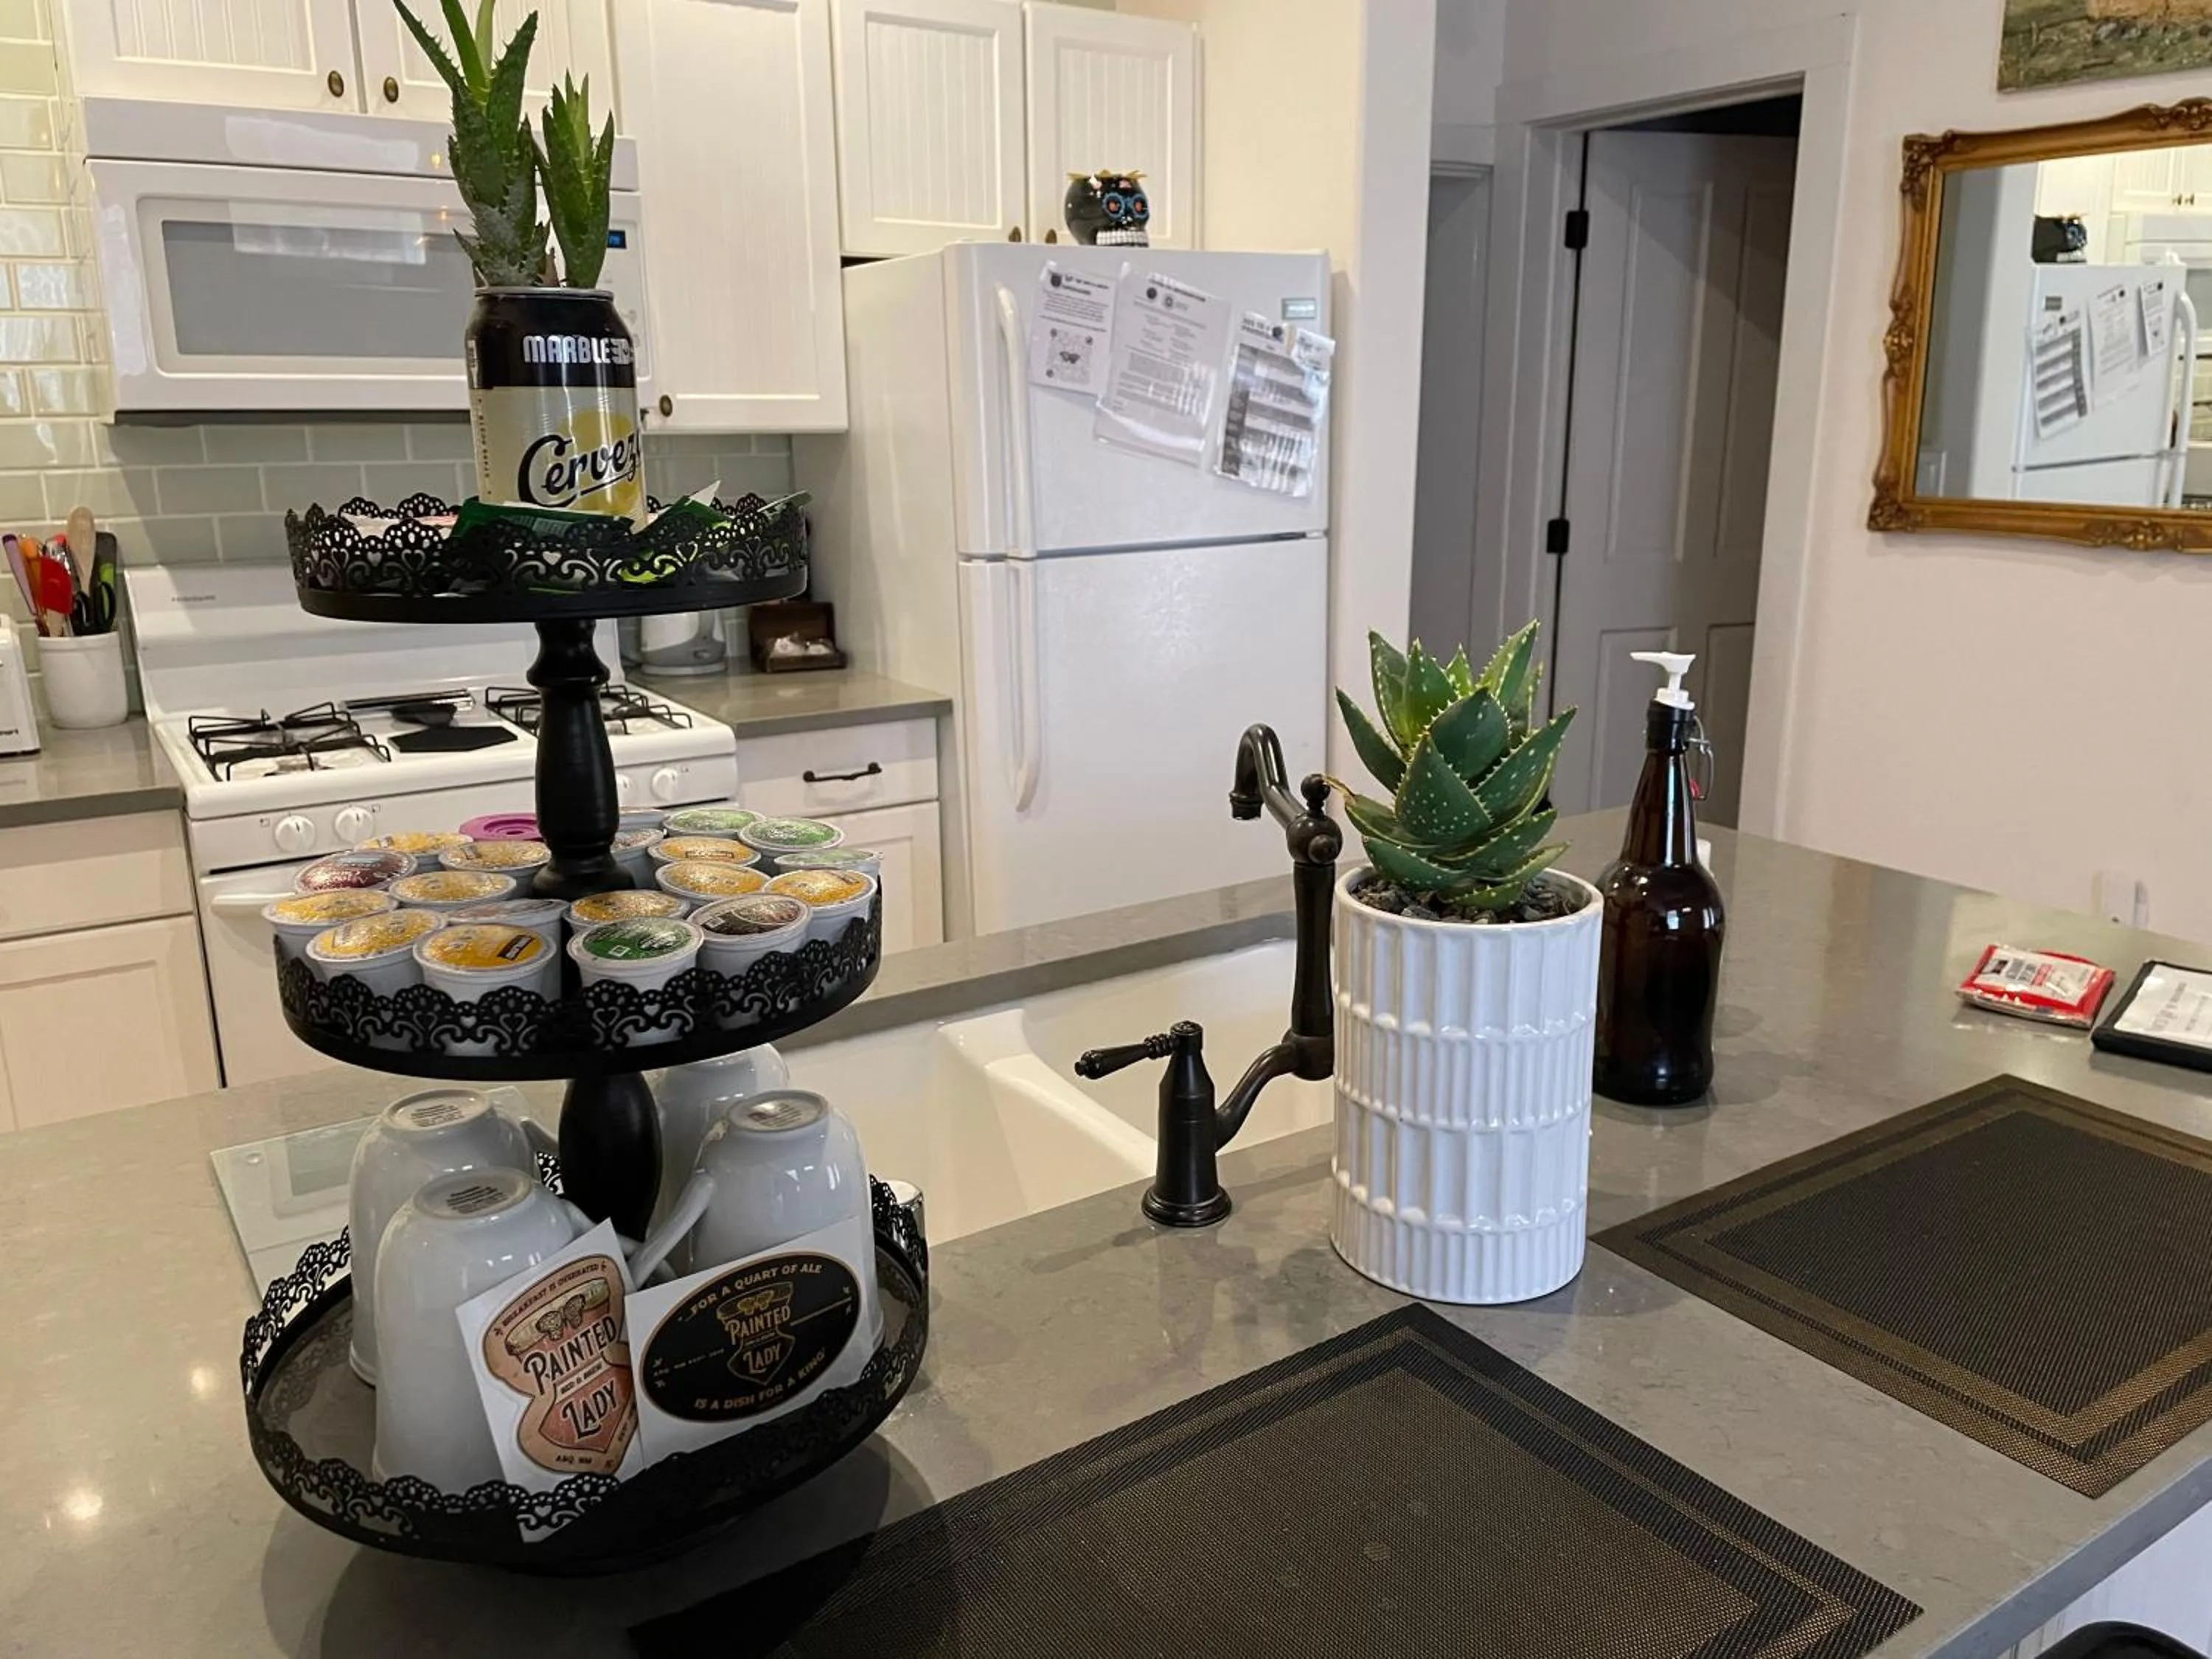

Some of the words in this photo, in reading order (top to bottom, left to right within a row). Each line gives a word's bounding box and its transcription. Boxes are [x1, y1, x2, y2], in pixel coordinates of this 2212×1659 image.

[523, 335, 611, 365] MARBLE
[721, 1286, 732, 1298] A
[734, 1267, 779, 1290] QUART
[782, 1263, 799, 1276] OF
[800, 1262, 823, 1275] ALE
[725, 1304, 791, 1346] PAINTED
[524, 1315, 616, 1395] PAINTED
[742, 1343, 782, 1374] LADY
[562, 1380, 616, 1440] LADY
[694, 1398, 707, 1410] IS
[710, 1399, 720, 1411] A
[723, 1394, 755, 1410] DISH
[759, 1385, 784, 1402] FOR
[787, 1377, 796, 1389] A
